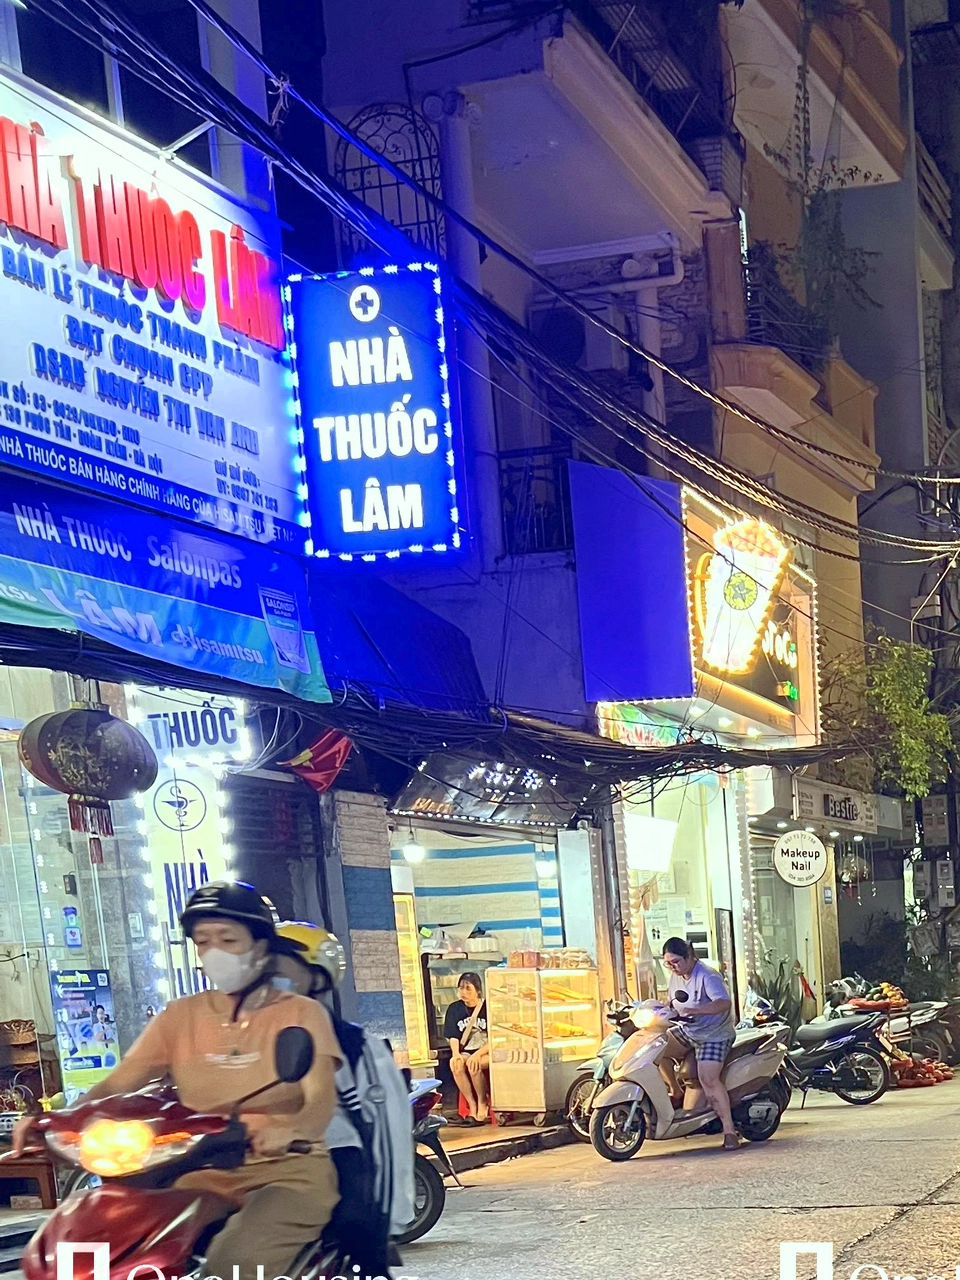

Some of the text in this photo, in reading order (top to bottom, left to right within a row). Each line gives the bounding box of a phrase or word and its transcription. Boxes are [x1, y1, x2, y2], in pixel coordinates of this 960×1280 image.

[329, 326, 413, 387] NHÀ
[313, 393, 438, 462] THUỐC
[69, 457, 93, 480] BÁN
[95, 464, 126, 490] HÀNG
[128, 476, 160, 501] CHÍNH
[340, 477, 424, 532] LÂM
[12, 501, 61, 544] NHÀ
[147, 535, 243, 589] Salonpas
[171, 623, 264, 665] Hisamitsu
[147, 696, 238, 750] THUỐC
[824, 794, 859, 821] Bestie
[781, 848, 820, 860] Makeup
[791, 861, 811, 870] Nail
